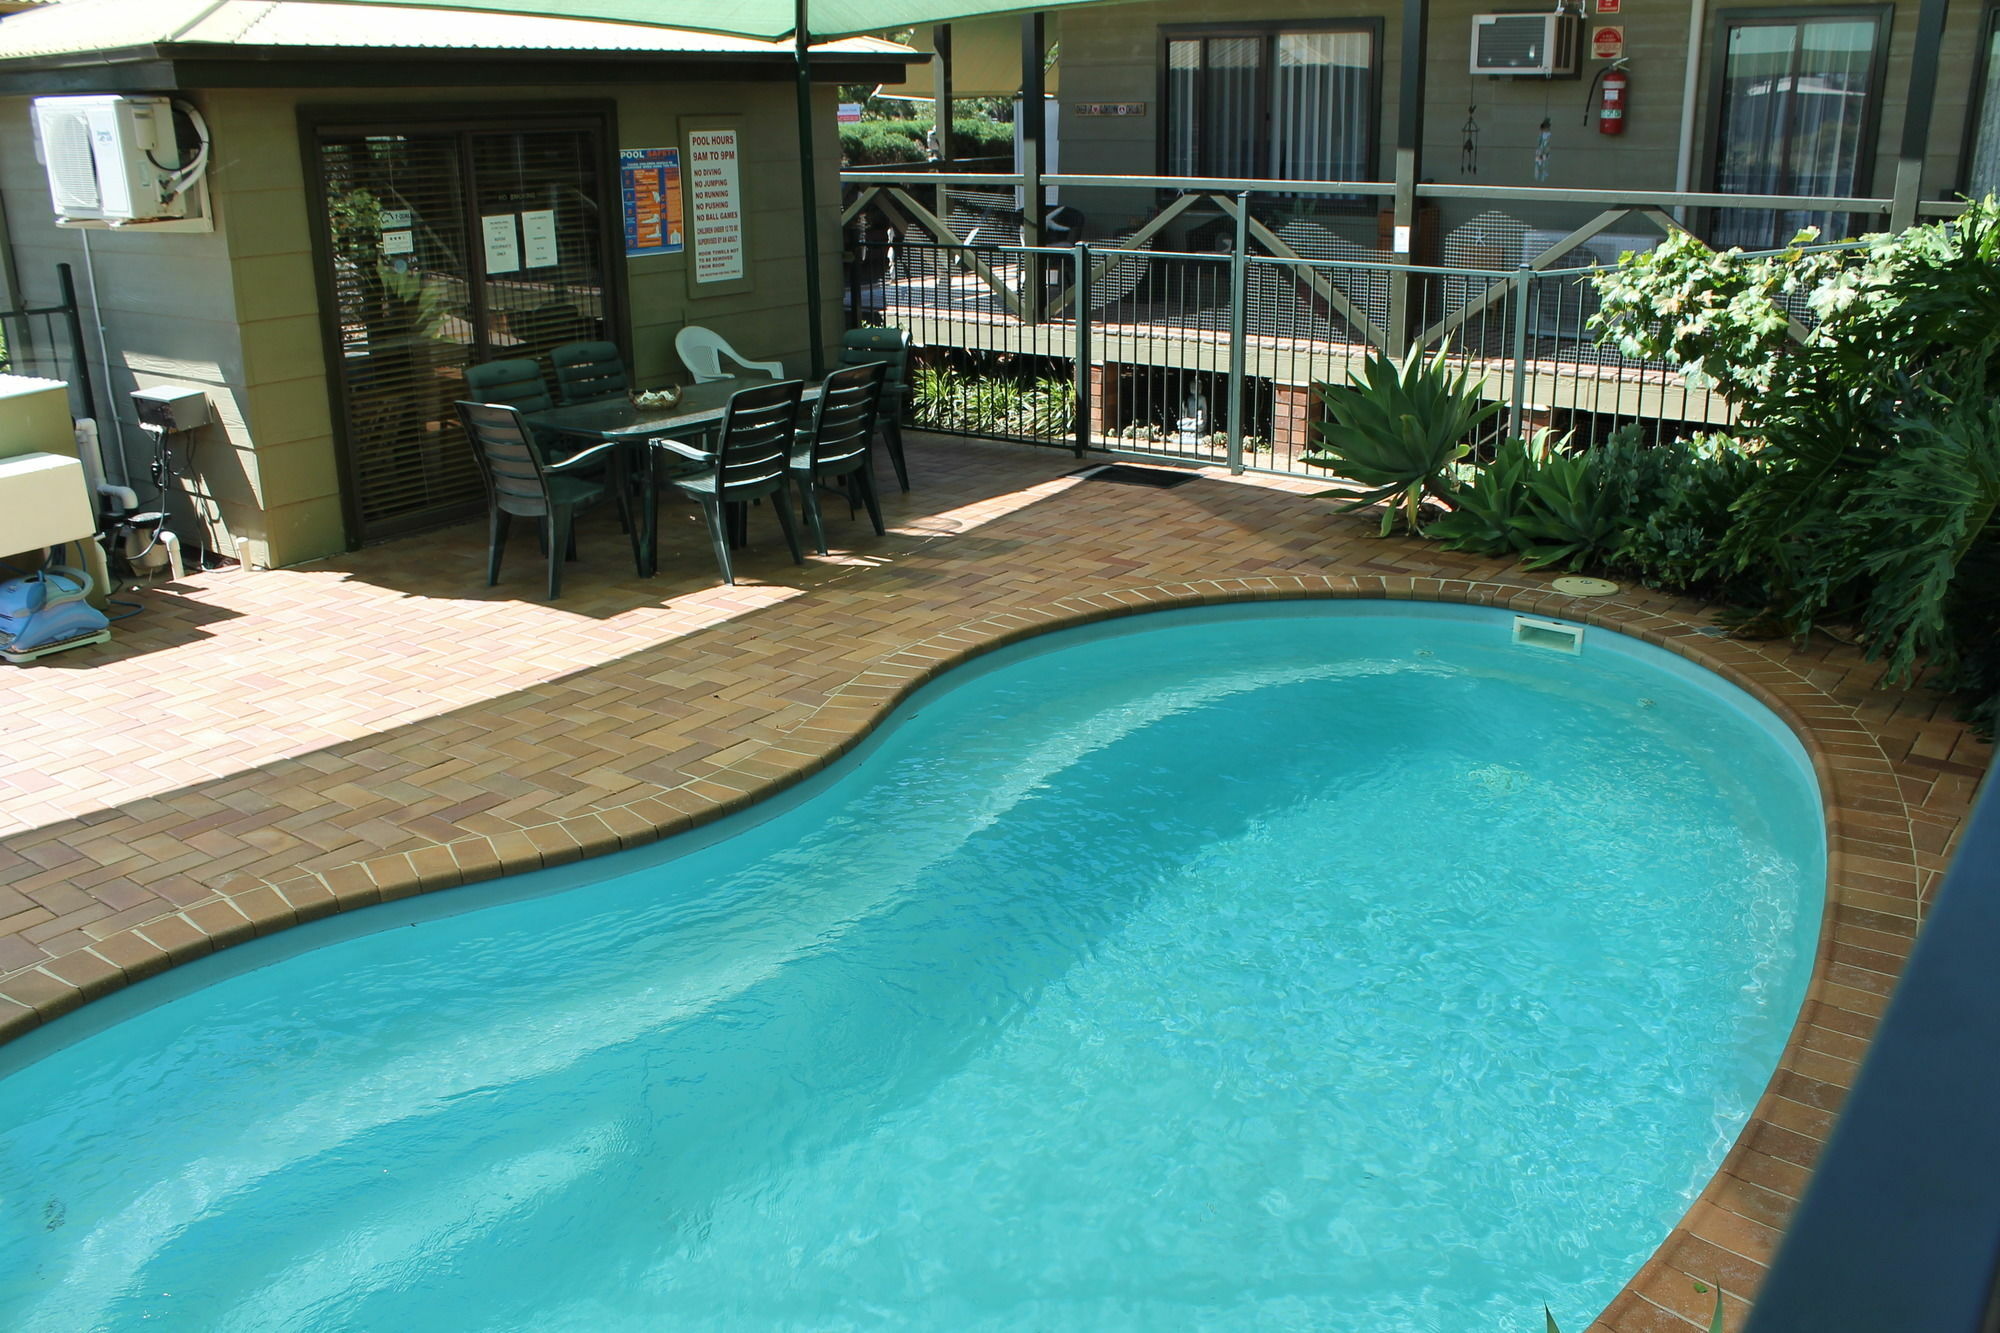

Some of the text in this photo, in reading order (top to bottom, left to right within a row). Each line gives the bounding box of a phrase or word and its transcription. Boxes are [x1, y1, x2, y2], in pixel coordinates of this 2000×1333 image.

[692, 135, 734, 146] POOL HOURS
[620, 151, 645, 159] POOL
[693, 150, 735, 161] 9AM TO 9PM
[703, 168, 722, 176] DIVING
[695, 178, 728, 188] NO JUMPING
[696, 190, 729, 199] NO RUNNING
[705, 201, 729, 209] PUSHING
[697, 211, 738, 222] NO BALL GAMES
[697, 227, 713, 235] CHILDREN
[714, 225, 724, 233] UNDER
[698, 237, 717, 245] SUPERVISED
